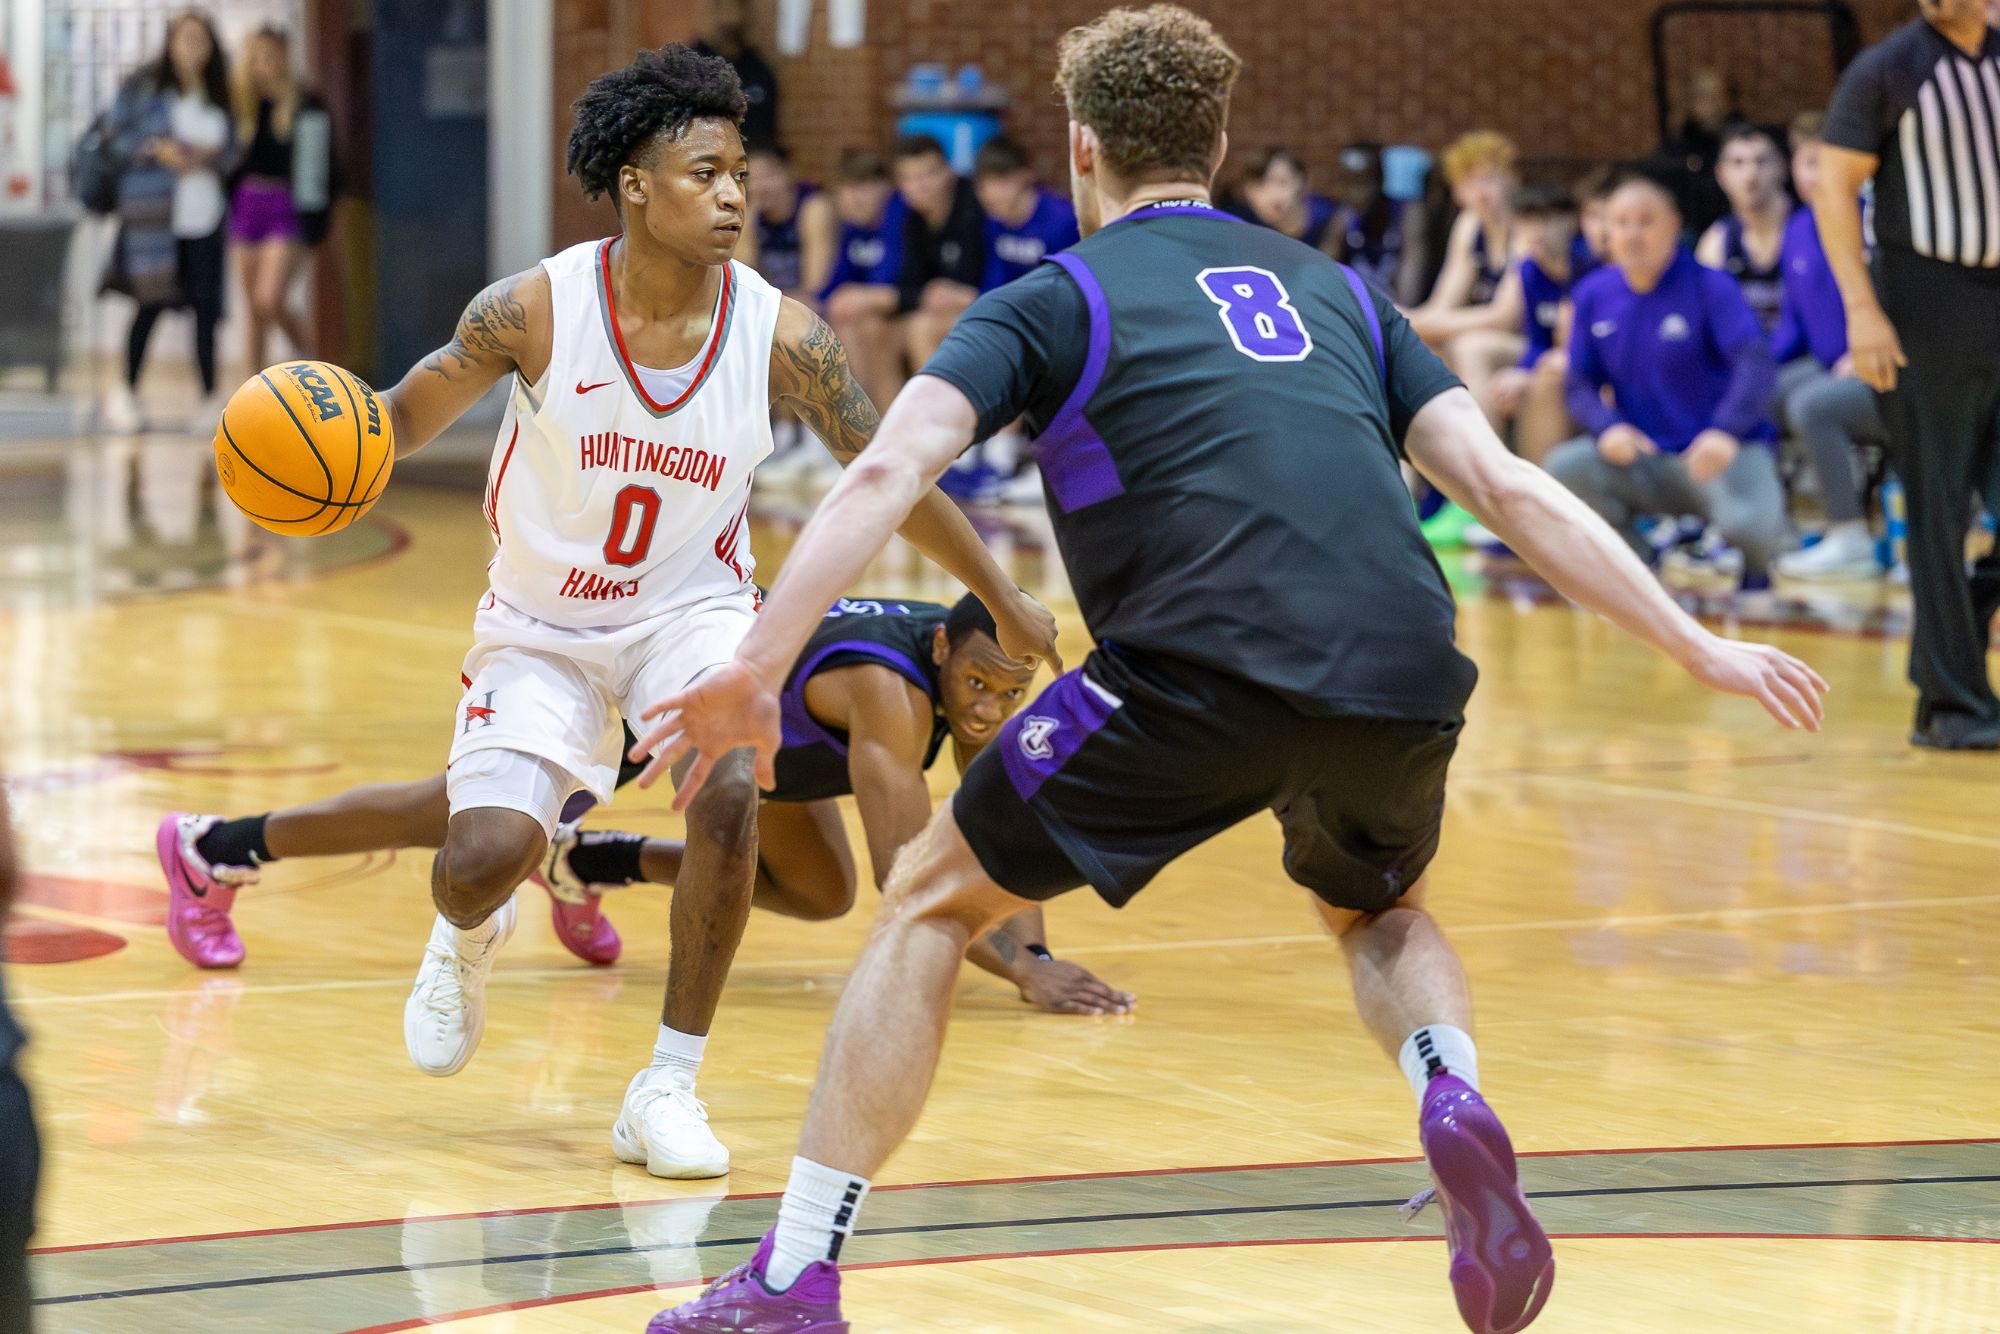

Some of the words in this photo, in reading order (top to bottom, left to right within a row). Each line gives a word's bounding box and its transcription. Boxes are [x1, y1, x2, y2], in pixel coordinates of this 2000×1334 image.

[1195, 265, 1314, 362] 8
[285, 364, 343, 422] NCAA
[580, 431, 727, 492] HUNTINGDON
[602, 483, 663, 568] 0
